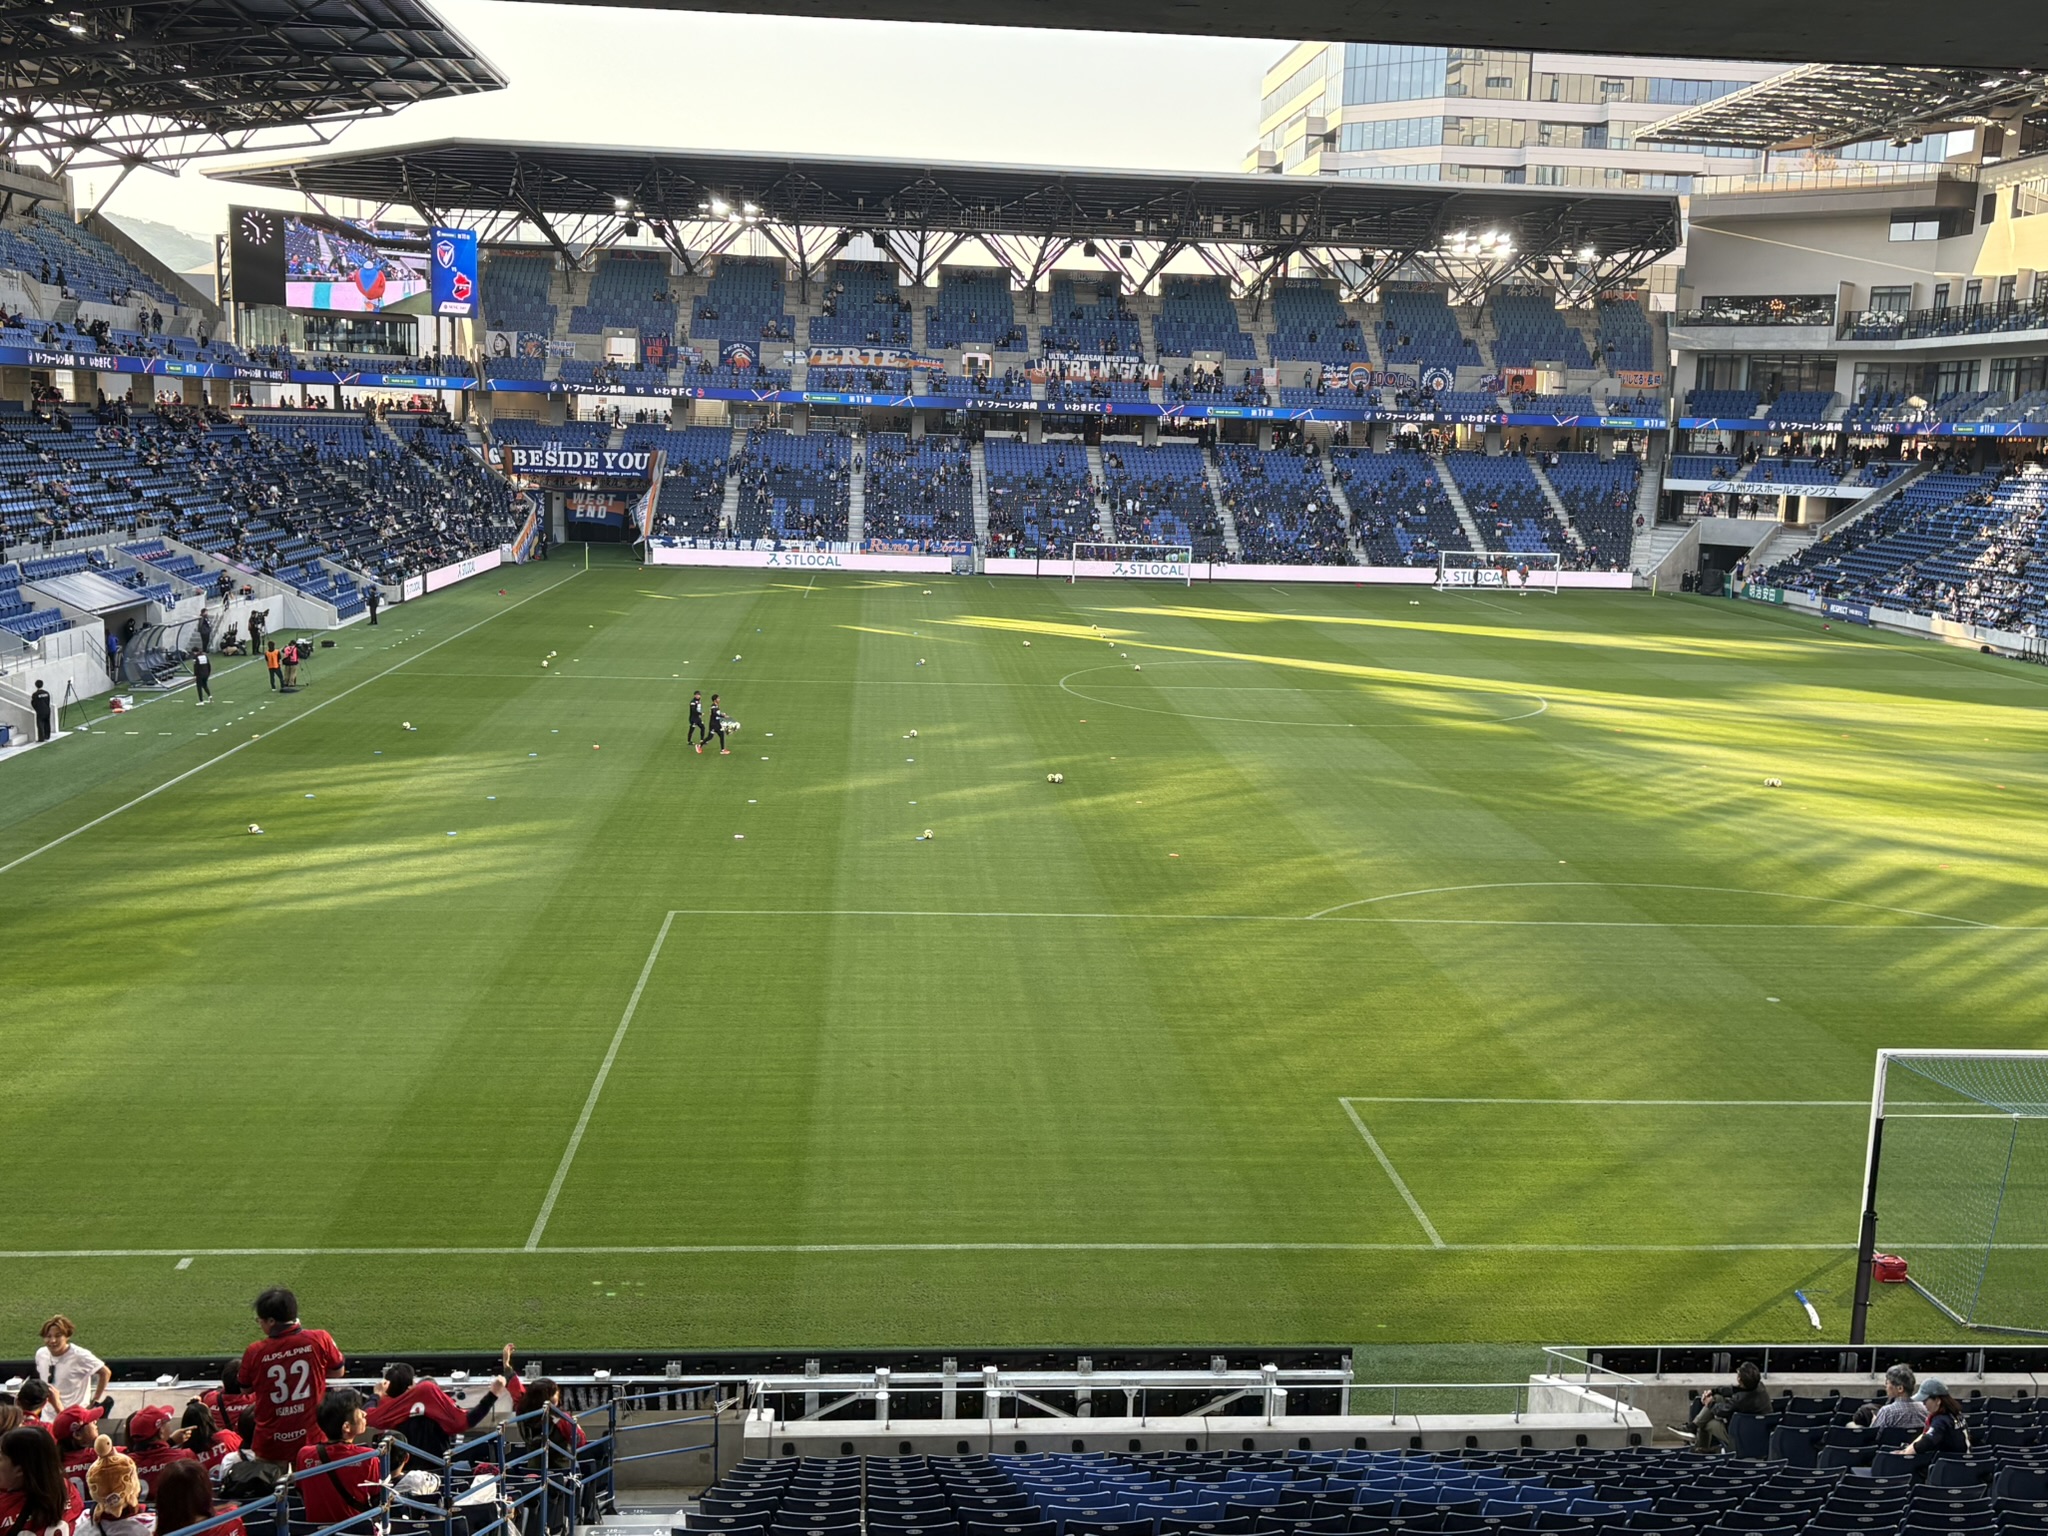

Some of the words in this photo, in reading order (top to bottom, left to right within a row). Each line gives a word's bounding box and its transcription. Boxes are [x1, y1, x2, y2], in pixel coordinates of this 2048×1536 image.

[1126, 355, 1139, 363] END
[513, 449, 598, 469] BESIDE
[602, 452, 650, 470] YOU
[1726, 482, 1838, 496] 九州ガスホールディングス
[572, 492, 615, 505] WEST
[576, 505, 607, 518] END
[785, 554, 842, 567] STLOCAL
[1130, 564, 1184, 576] STLOCAL
[1453, 571, 1501, 582] STLOCA
[267, 1360, 311, 1404] 32
[273, 1428, 307, 1442] ROHTO
[212, 1443, 226, 1457] FC
